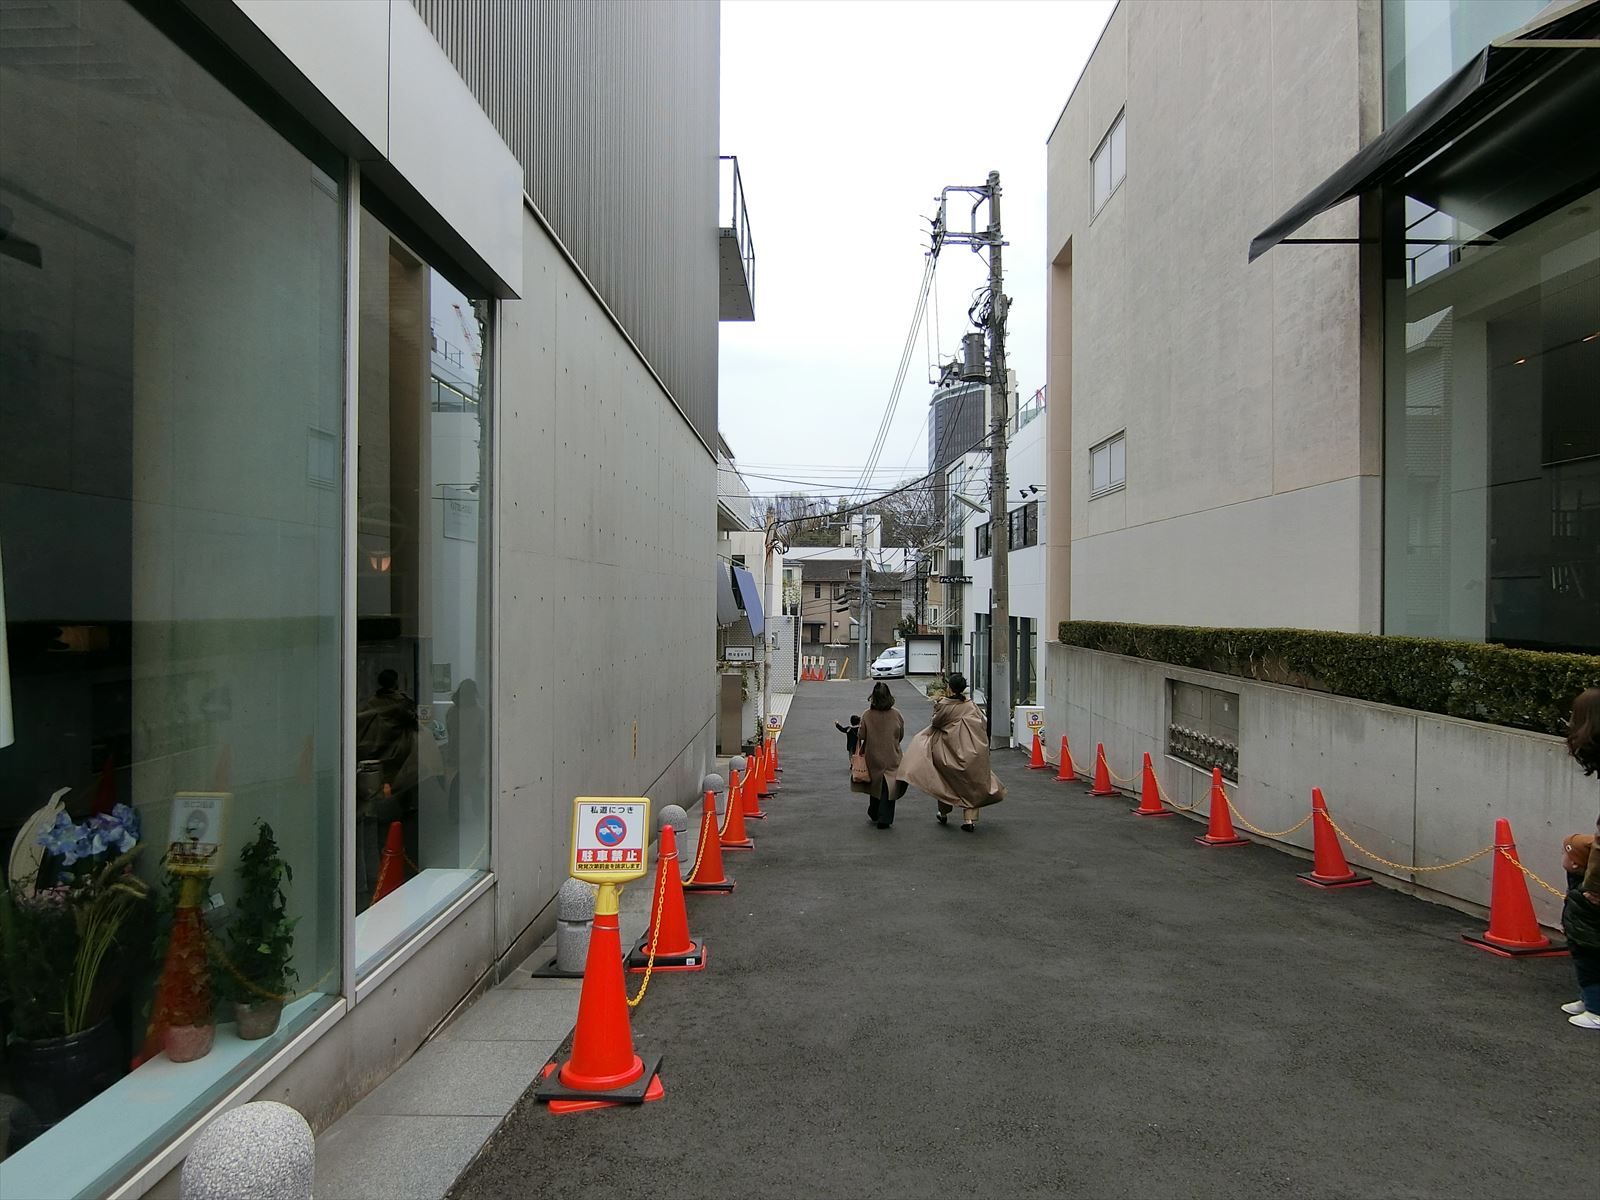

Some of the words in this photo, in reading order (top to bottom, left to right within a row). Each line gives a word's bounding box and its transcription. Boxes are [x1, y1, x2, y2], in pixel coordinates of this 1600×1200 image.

[591, 806, 634, 814] 私道につき
[582, 850, 637, 862] 駐車禁止
